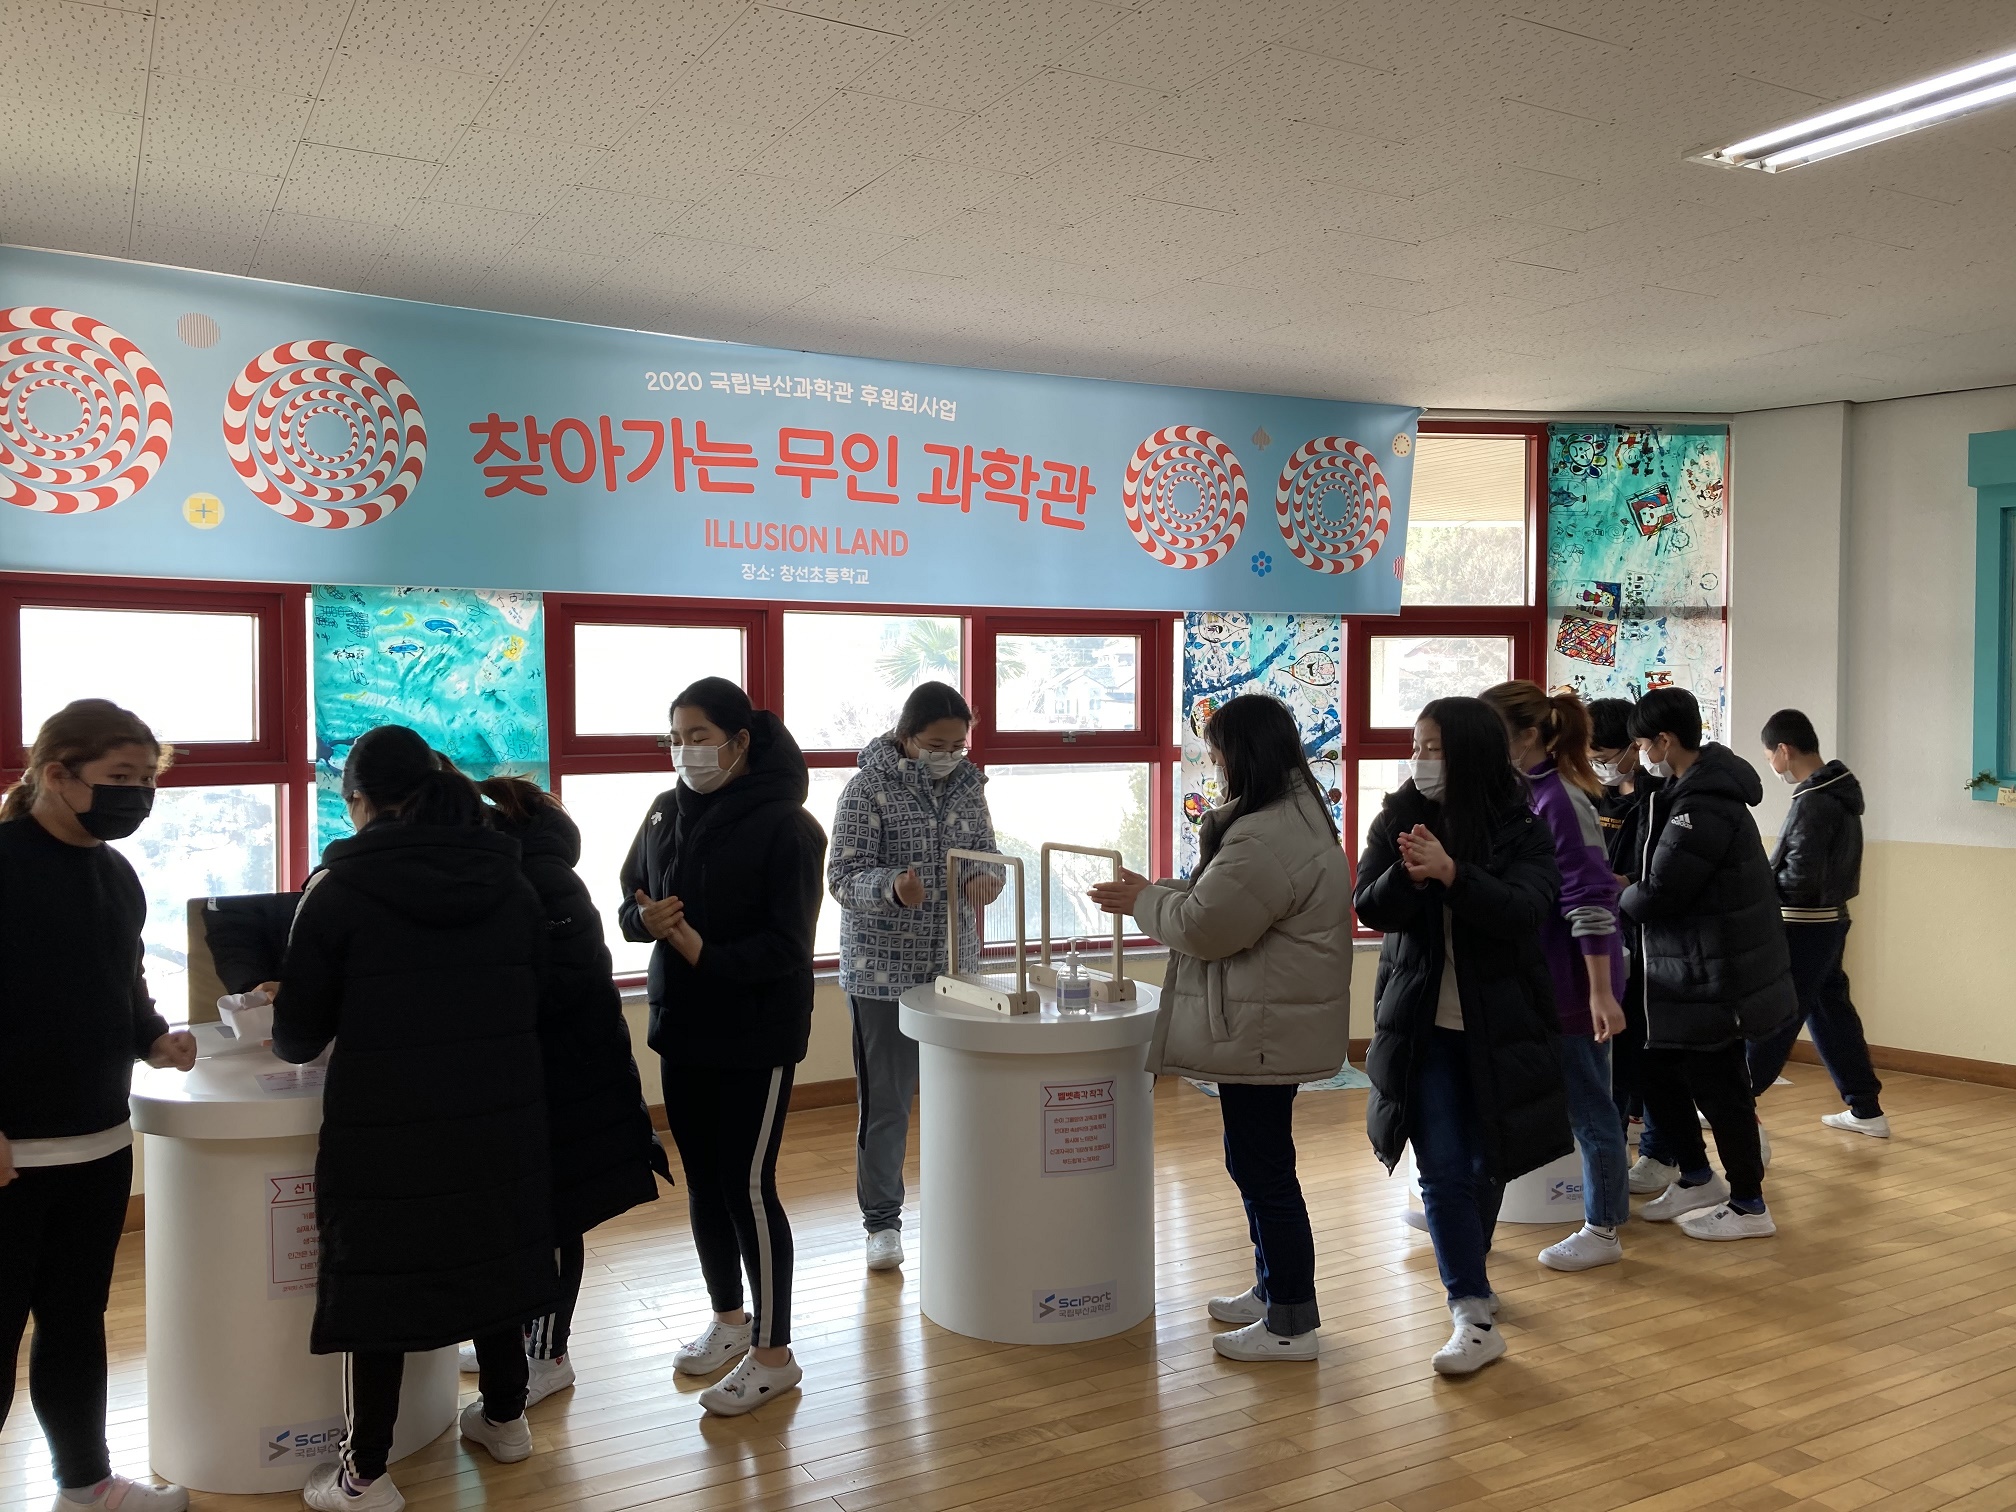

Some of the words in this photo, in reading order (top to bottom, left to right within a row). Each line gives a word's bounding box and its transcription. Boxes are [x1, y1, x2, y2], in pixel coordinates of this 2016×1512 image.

[644, 370, 703, 392] 2020
[709, 371, 854, 404] 국립부산과학관
[859, 383, 958, 422] 후원회사업
[468, 412, 759, 499] 찾아가는
[774, 426, 900, 505] 무인
[916, 443, 1097, 532] 과학관
[704, 518, 828, 554] ILLUSION
[835, 526, 909, 557] LAND
[740, 563, 775, 581] 장소:
[779, 564, 871, 585] 창선초등학교
[1671, 818, 1693, 830] adidas
[1057, 1090, 1089, 1101] 벨벳촉각
[1089, 1088, 1104, 1098] 착각
[294, 1182, 316, 1195] 신기
[1565, 1184, 1584, 1193] Sci
[1058, 1291, 1112, 1309] SciPort
[1059, 1302, 1112, 1318] 국립부산과학관
[294, 1441, 340, 1459] 국립부산
